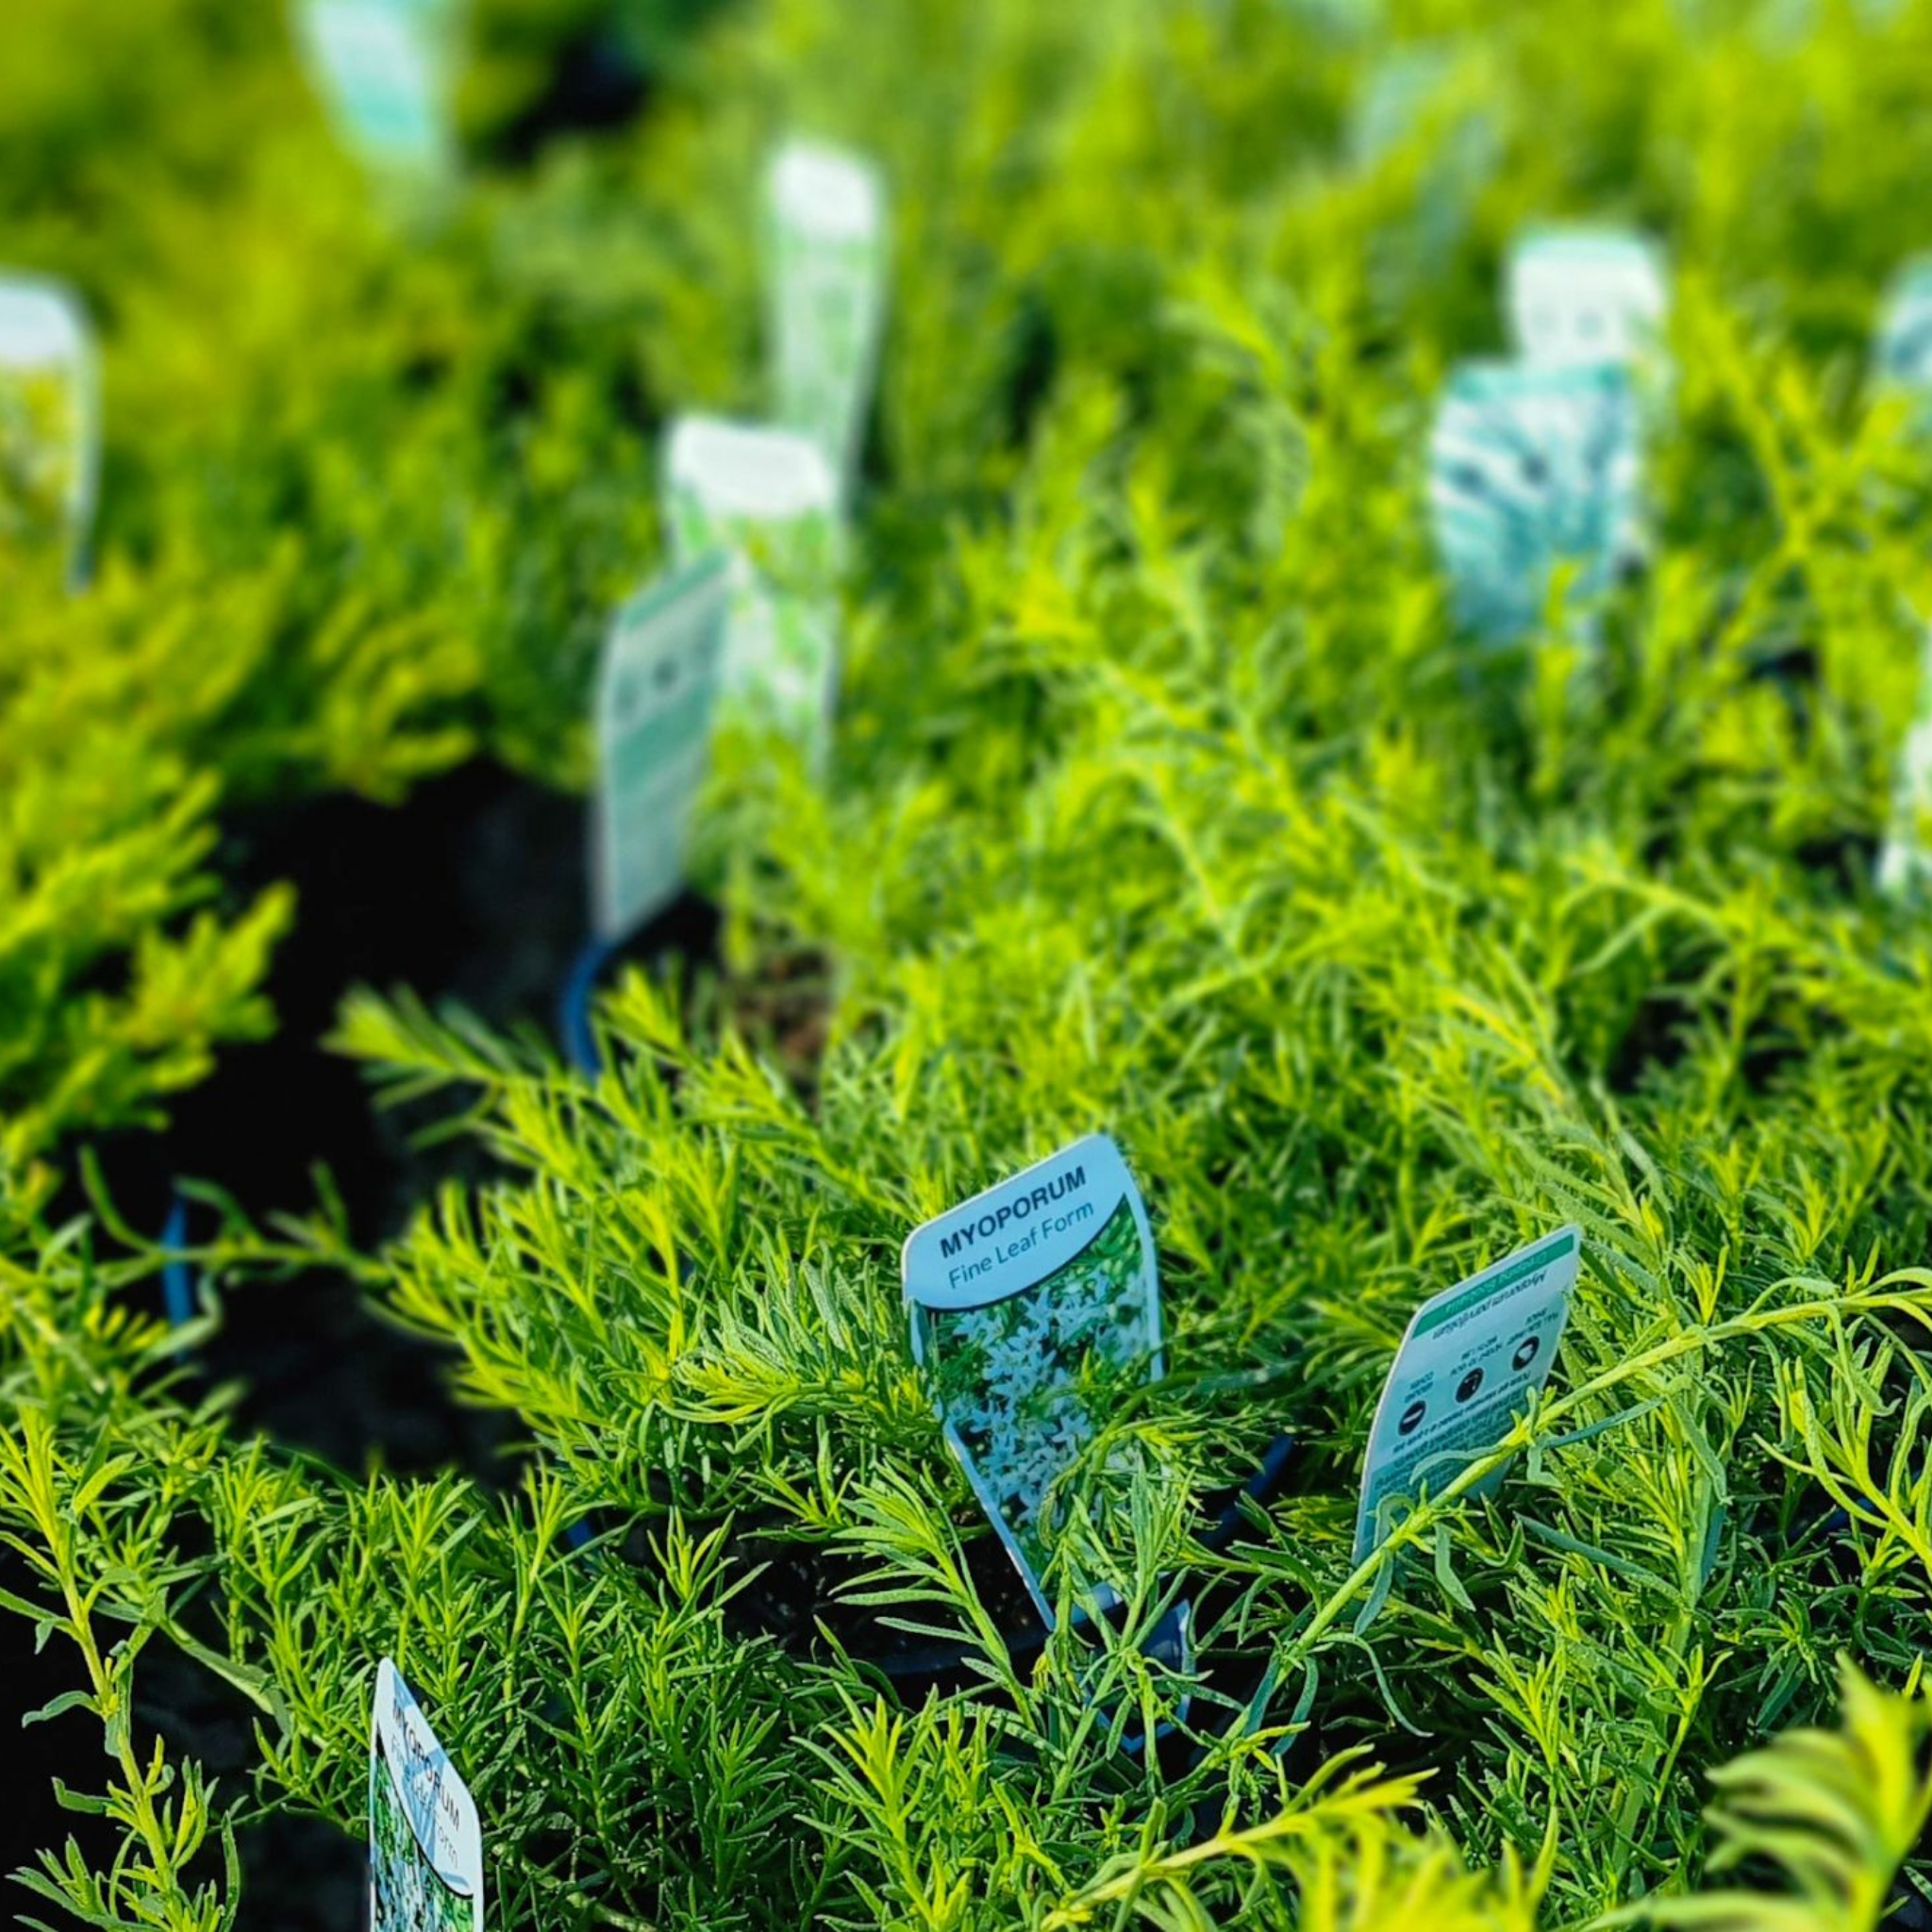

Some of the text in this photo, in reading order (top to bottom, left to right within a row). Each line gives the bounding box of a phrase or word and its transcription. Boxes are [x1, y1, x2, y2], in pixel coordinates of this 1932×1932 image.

[940, 1166, 1086, 1257] MYOPORUM
[947, 1202, 1094, 1290] Fine Leaf Form
